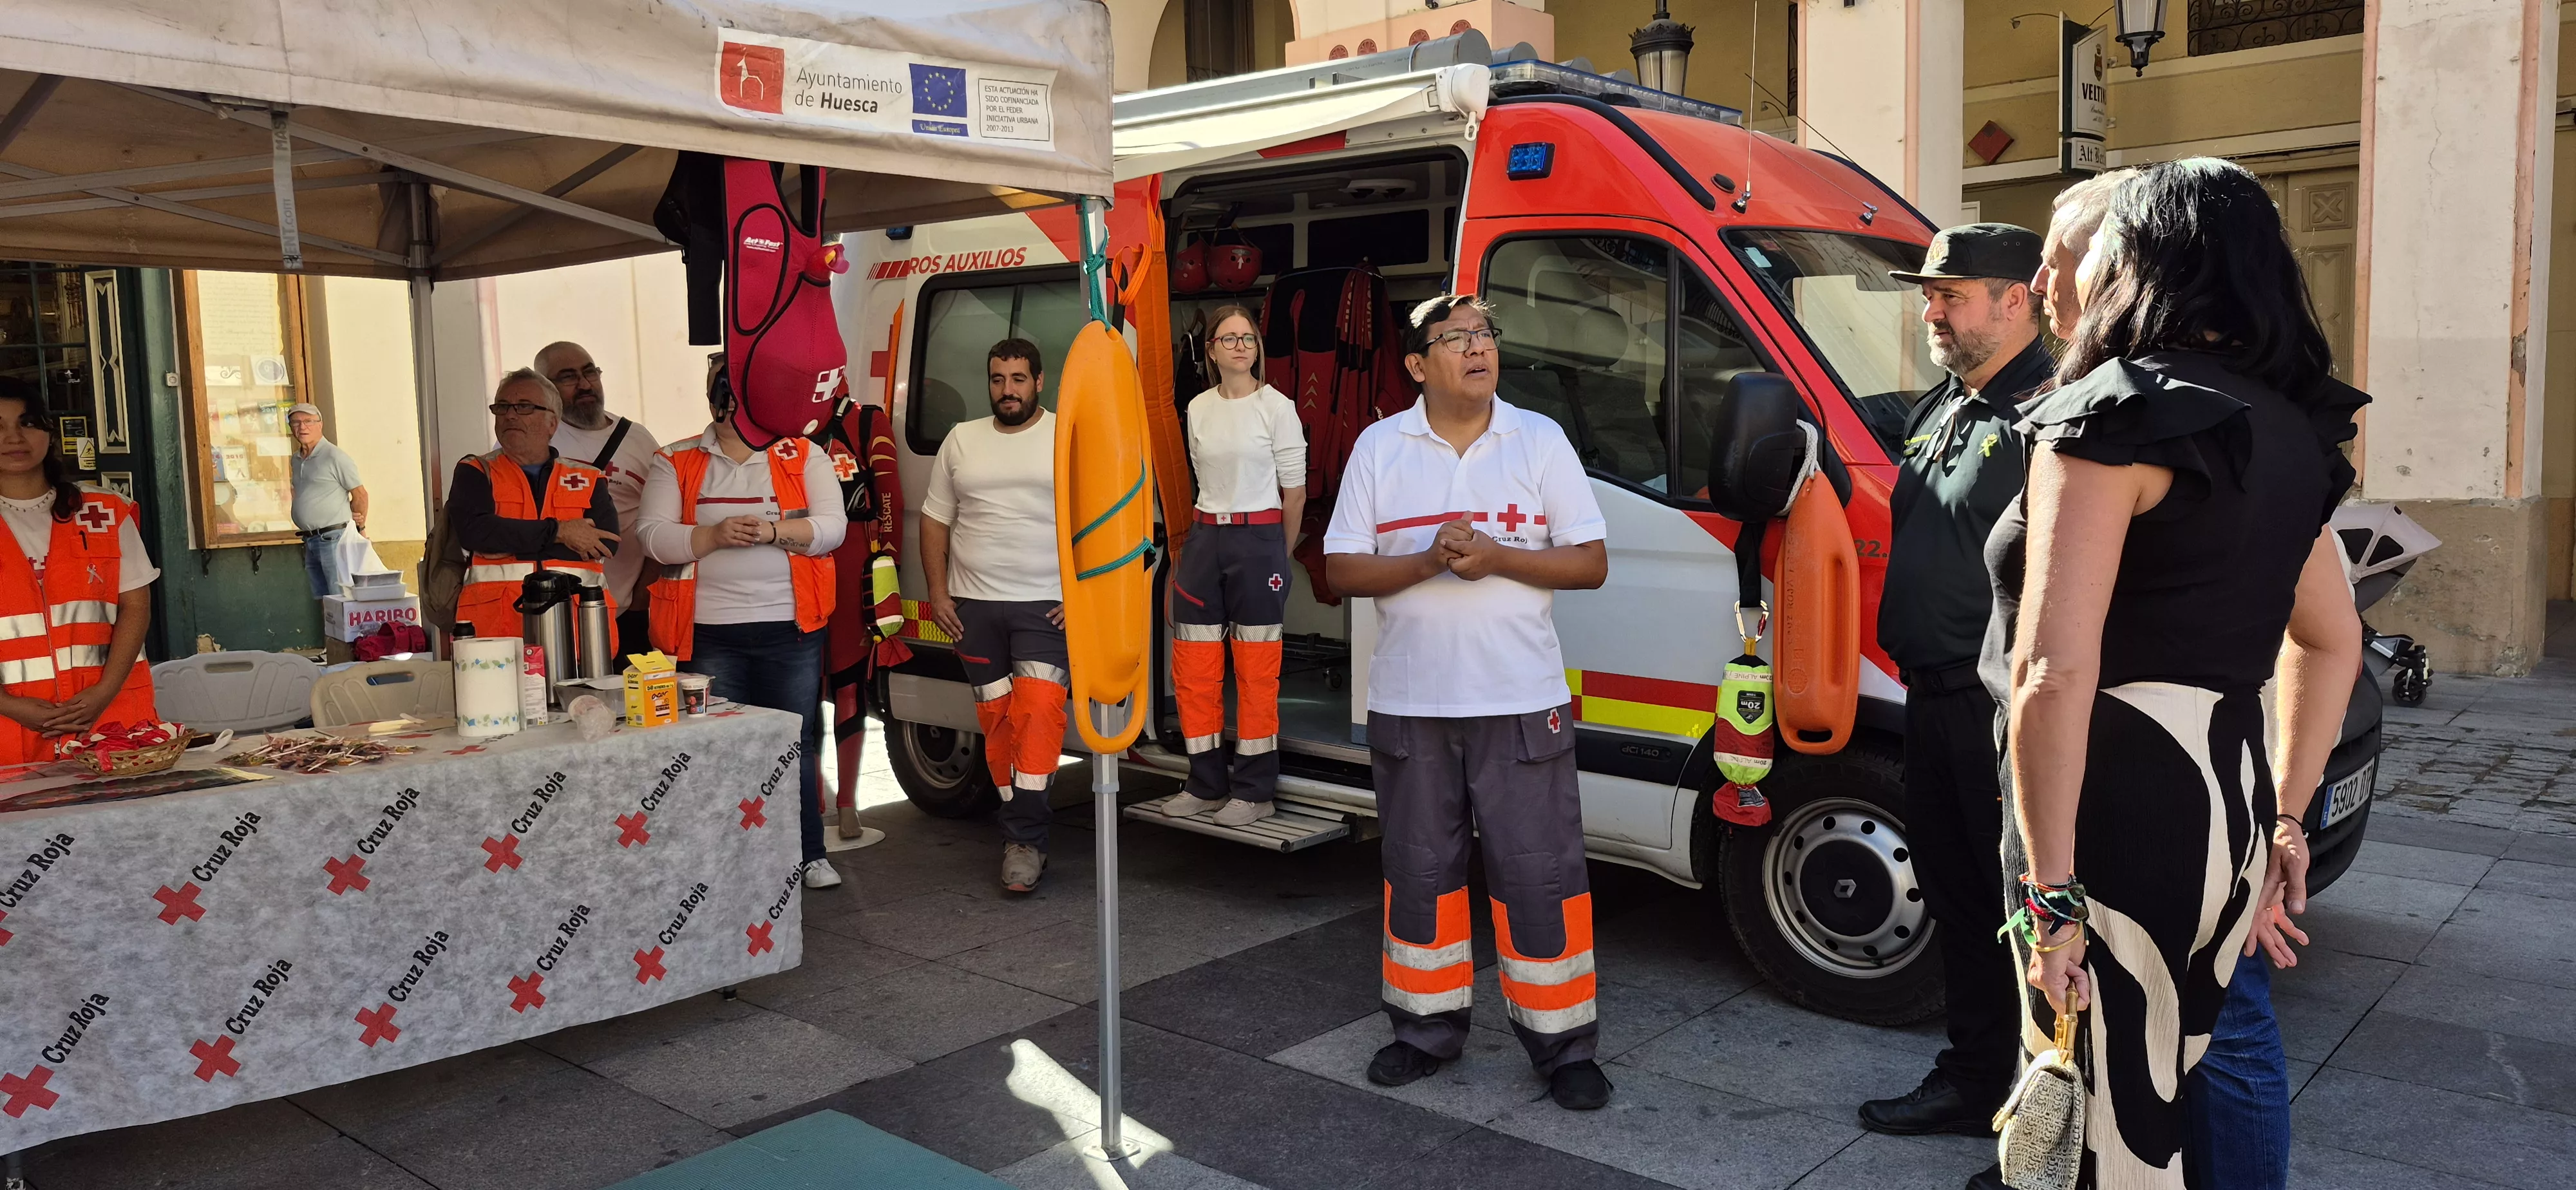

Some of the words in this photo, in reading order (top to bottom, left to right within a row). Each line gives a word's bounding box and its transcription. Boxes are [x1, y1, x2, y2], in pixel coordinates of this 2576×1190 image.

[796, 67, 903, 94] Ayuntamiento
[985, 85, 998, 93] ESTA
[999, 86, 1030, 95] ACTUACIÓN
[795, 90, 815, 108] de
[820, 91, 878, 113] Huesca
[986, 115, 1016, 124] INICIATIVA
[999, 97, 1039, 106] COFINANCIADA
[986, 124, 1014, 133] 2007-2013
[2079, 144, 2094, 162] Alt
[908, 254, 943, 275] ROS
[943, 247, 1028, 273] AUXILIOS
[881, 492, 893, 533] RESCATE
[348, 607, 418, 627] HARIBO
[1740, 701, 1761, 710] 20m
[761, 766, 784, 797] Cruz
[777, 741, 801, 769] Roja
[1640, 748, 1660, 757] 140
[641, 780, 670, 811] Cruz
[661, 752, 692, 783] Roja
[2331, 776, 2358, 818] 5902
[357, 818, 395, 855] Cruz
[383, 788, 421, 822] Roja
[511, 800, 544, 834] Cruz
[533, 771, 567, 804] Roja
[192, 844, 233, 882] Cruz
[220, 811, 262, 848] Roja
[0, 869, 41, 908] Cruz
[26, 833, 75, 872] Roja
[658, 911, 688, 945] Cruz
[679, 882, 709, 914] Roja
[768, 888, 791, 920] Cruz
[536, 936, 569, 971] Cruz
[557, 904, 591, 939] Roja
[388, 964, 424, 1002] Cruz
[412, 930, 450, 967] Roja
[225, 994, 265, 1035] Cruz
[252, 959, 293, 997] Roja
[41, 1025, 82, 1064] Cruz
[68, 993, 110, 1031] Roja
